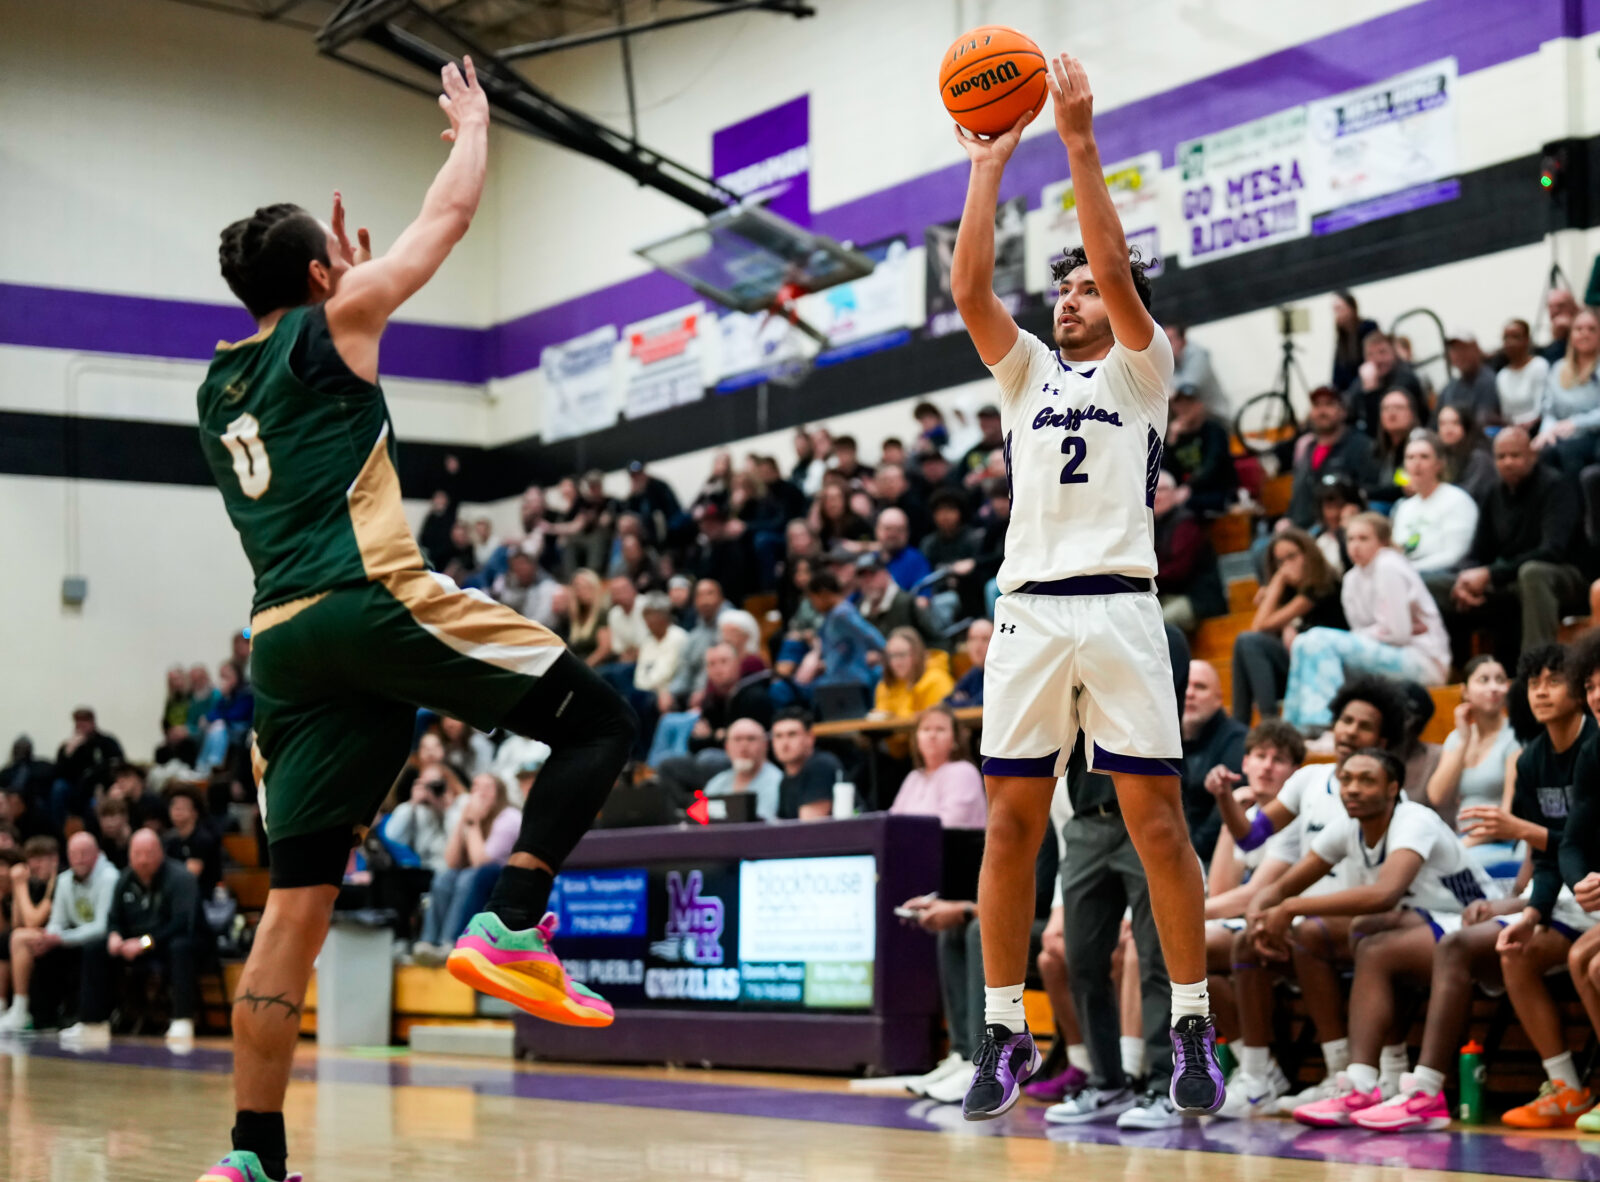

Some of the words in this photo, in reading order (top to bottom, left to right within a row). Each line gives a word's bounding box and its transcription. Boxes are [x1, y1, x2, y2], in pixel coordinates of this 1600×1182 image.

[949, 61, 1022, 97] Wilson
[1183, 185, 1213, 220] GO
[1226, 158, 1305, 210] MESA
[218, 411, 273, 501] 0
[1060, 436, 1088, 484] 2
